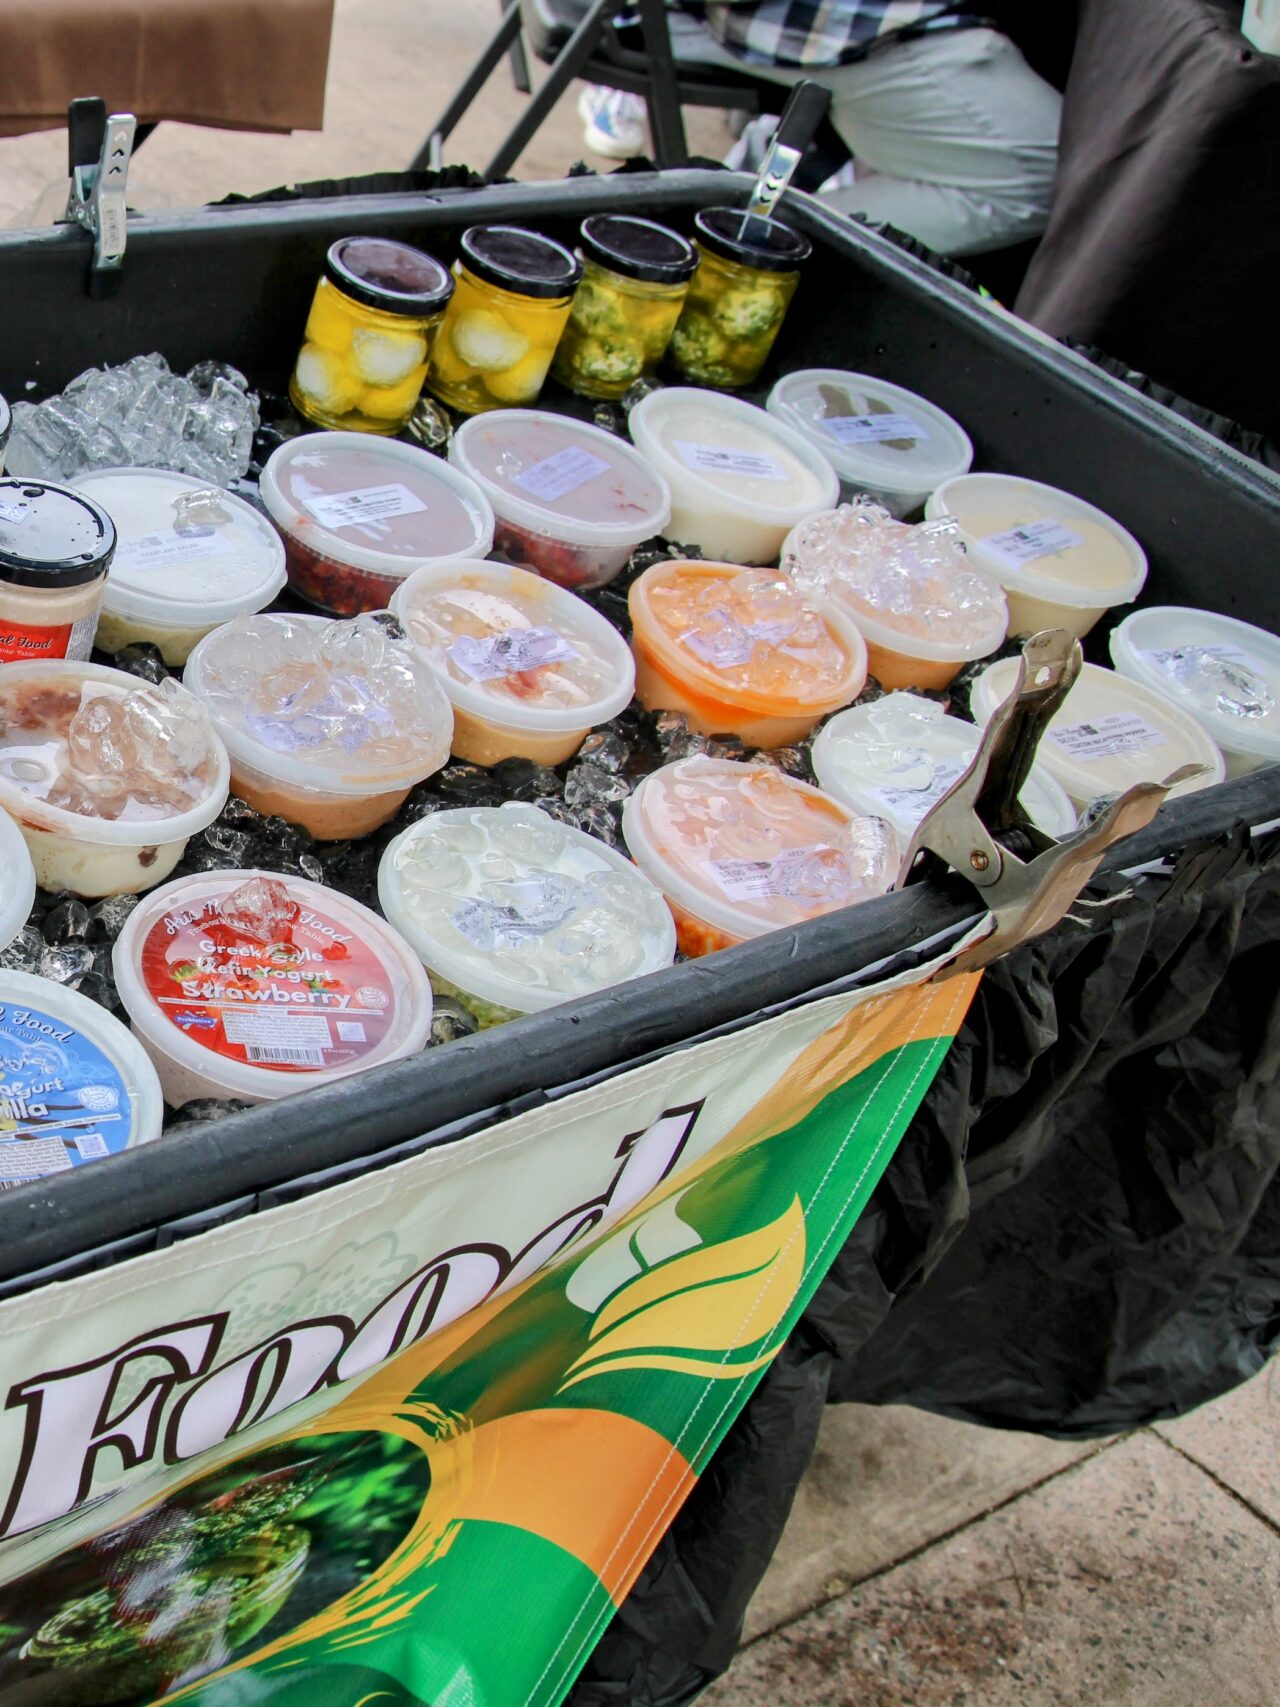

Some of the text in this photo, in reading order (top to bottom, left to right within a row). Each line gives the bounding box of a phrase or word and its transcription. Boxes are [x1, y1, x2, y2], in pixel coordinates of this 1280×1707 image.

[17, 637, 53, 649] Food
[164, 908, 354, 944] Aris Food
[198, 940, 260, 958] Greek
[256, 964, 334, 983] Yogurt
[181, 980, 352, 1009] Strawberry
[12, 1010, 74, 1044] Food
